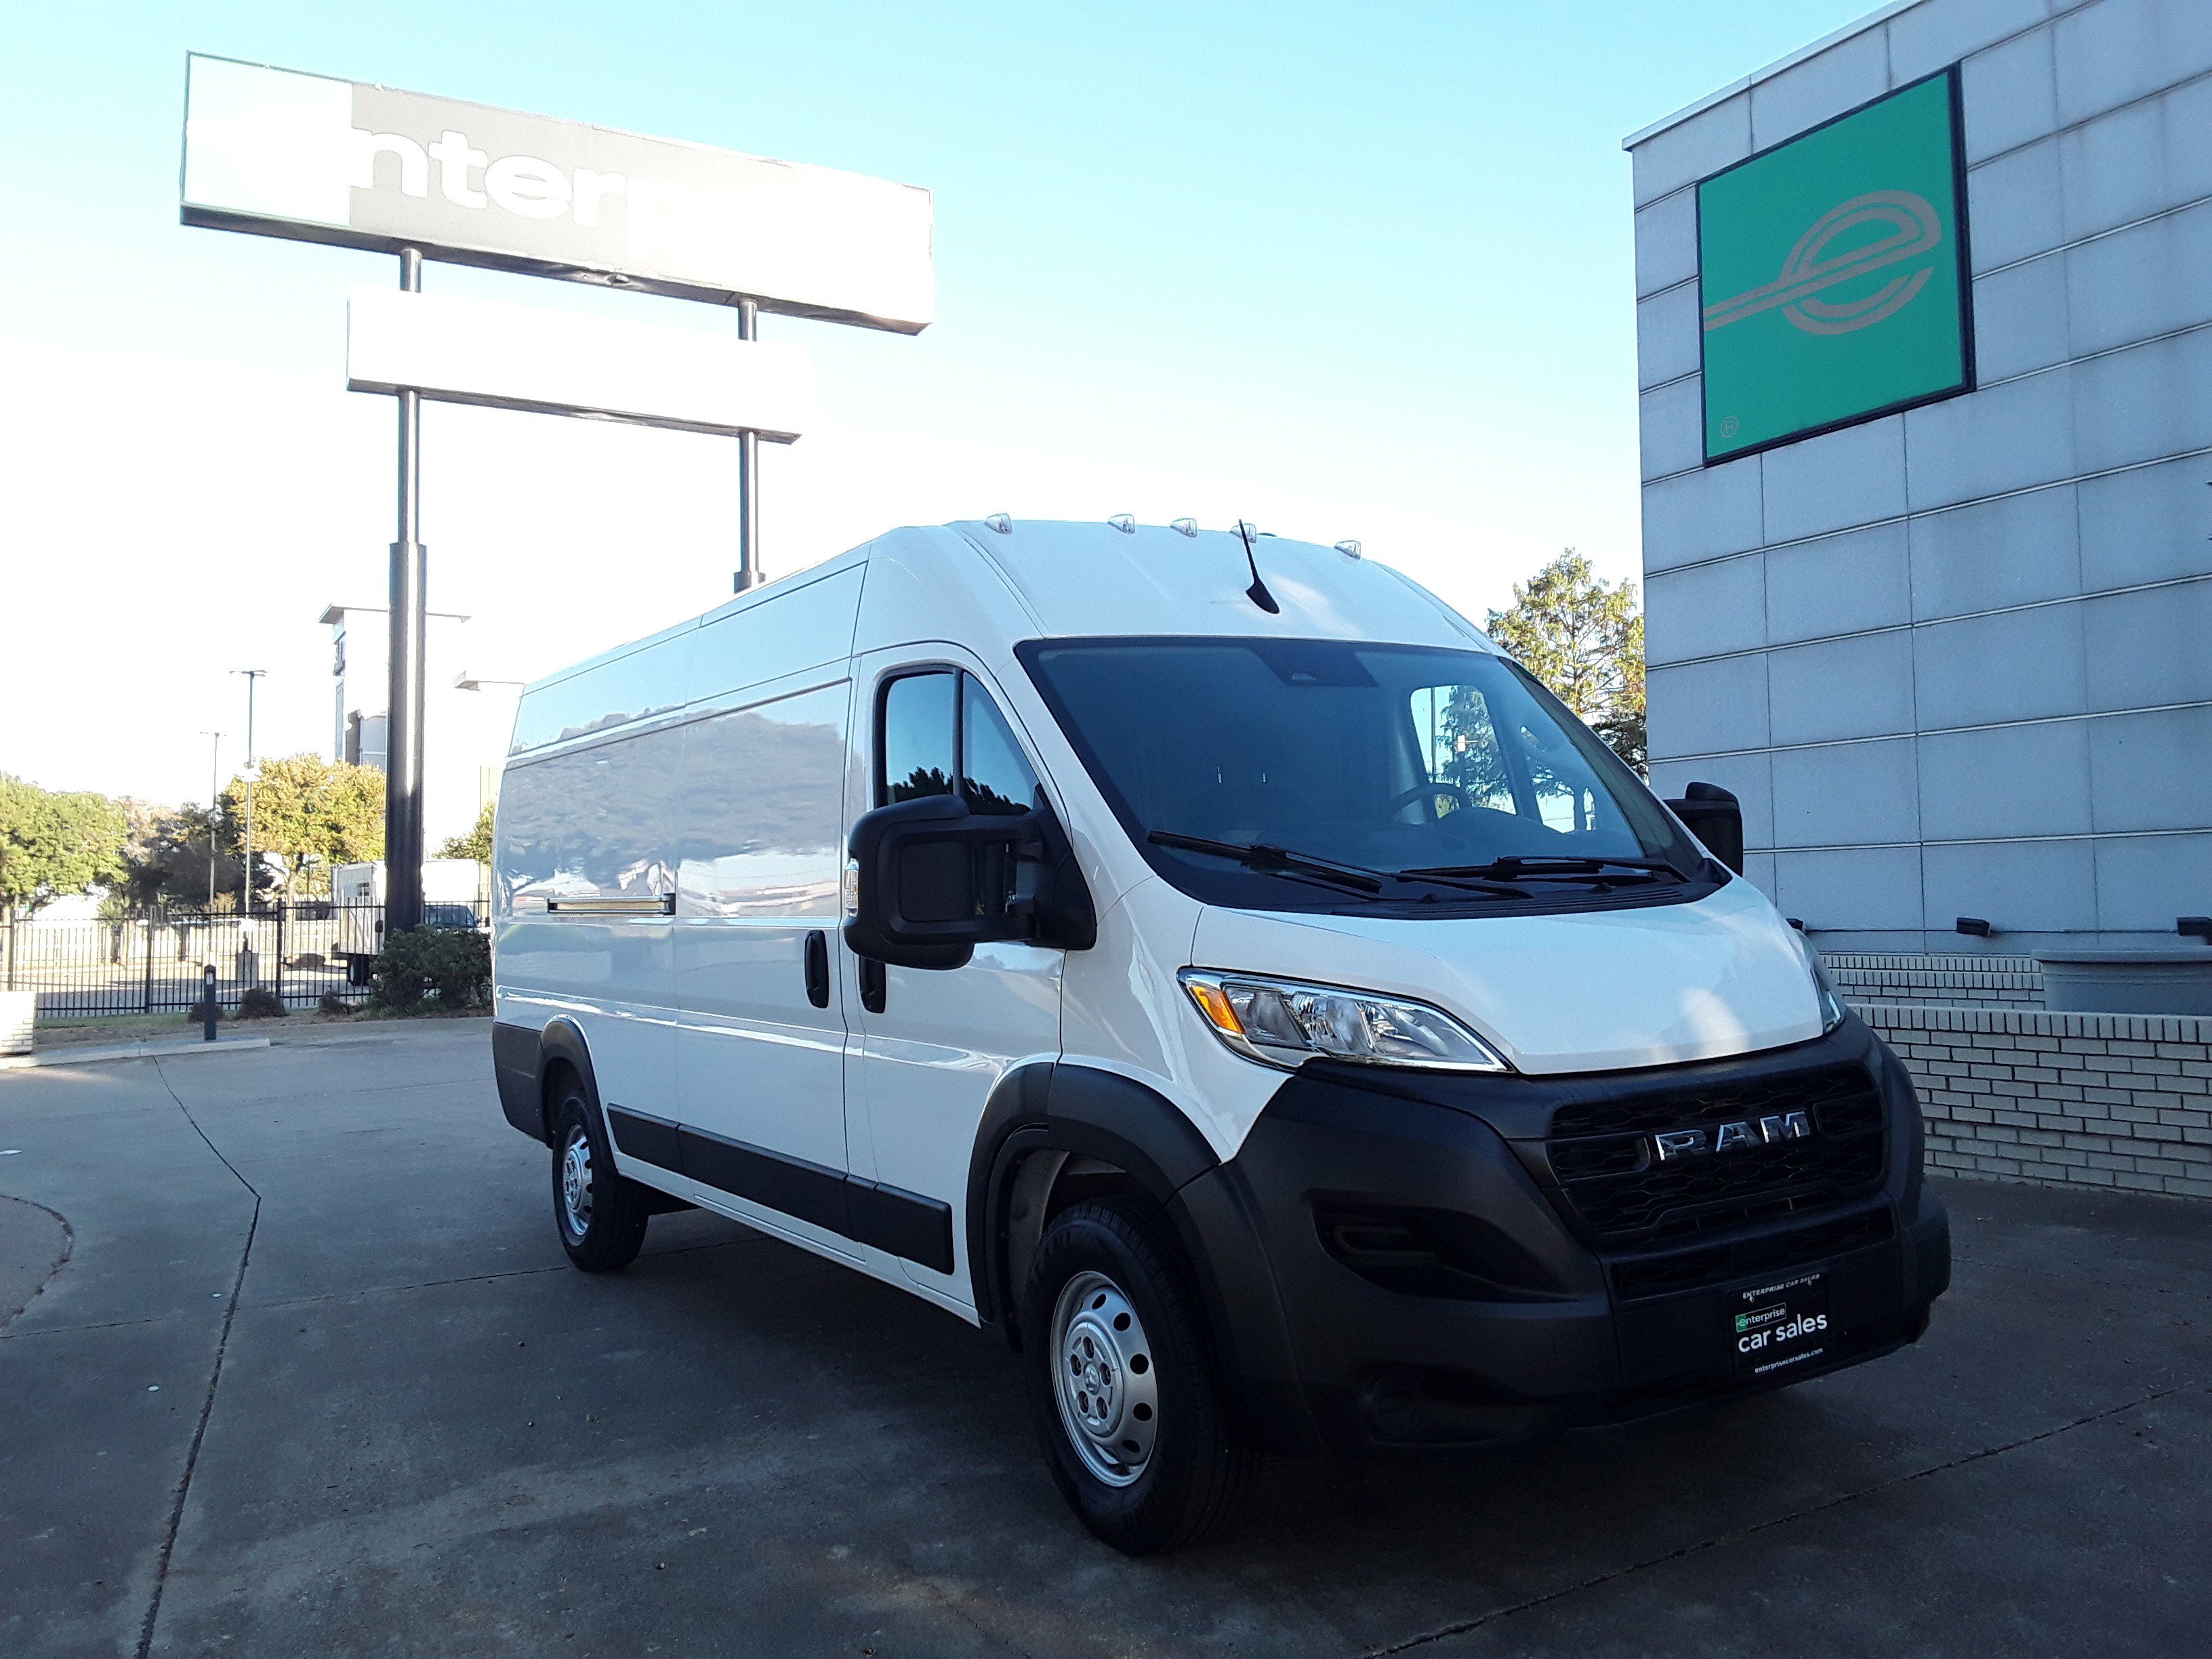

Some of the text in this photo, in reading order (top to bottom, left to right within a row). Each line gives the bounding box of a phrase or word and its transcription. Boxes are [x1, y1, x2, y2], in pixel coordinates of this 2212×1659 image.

[1655, 1111, 1811, 1162] RAM
[1742, 1283, 1785, 1300] ENTERPRISE
[1786, 1279, 1799, 1288] CAR
[1738, 1308, 1785, 1327] enterprise
[1738, 1313, 1828, 1353] car sales
[1755, 1347, 1824, 1374] enterprisecarsales.com
